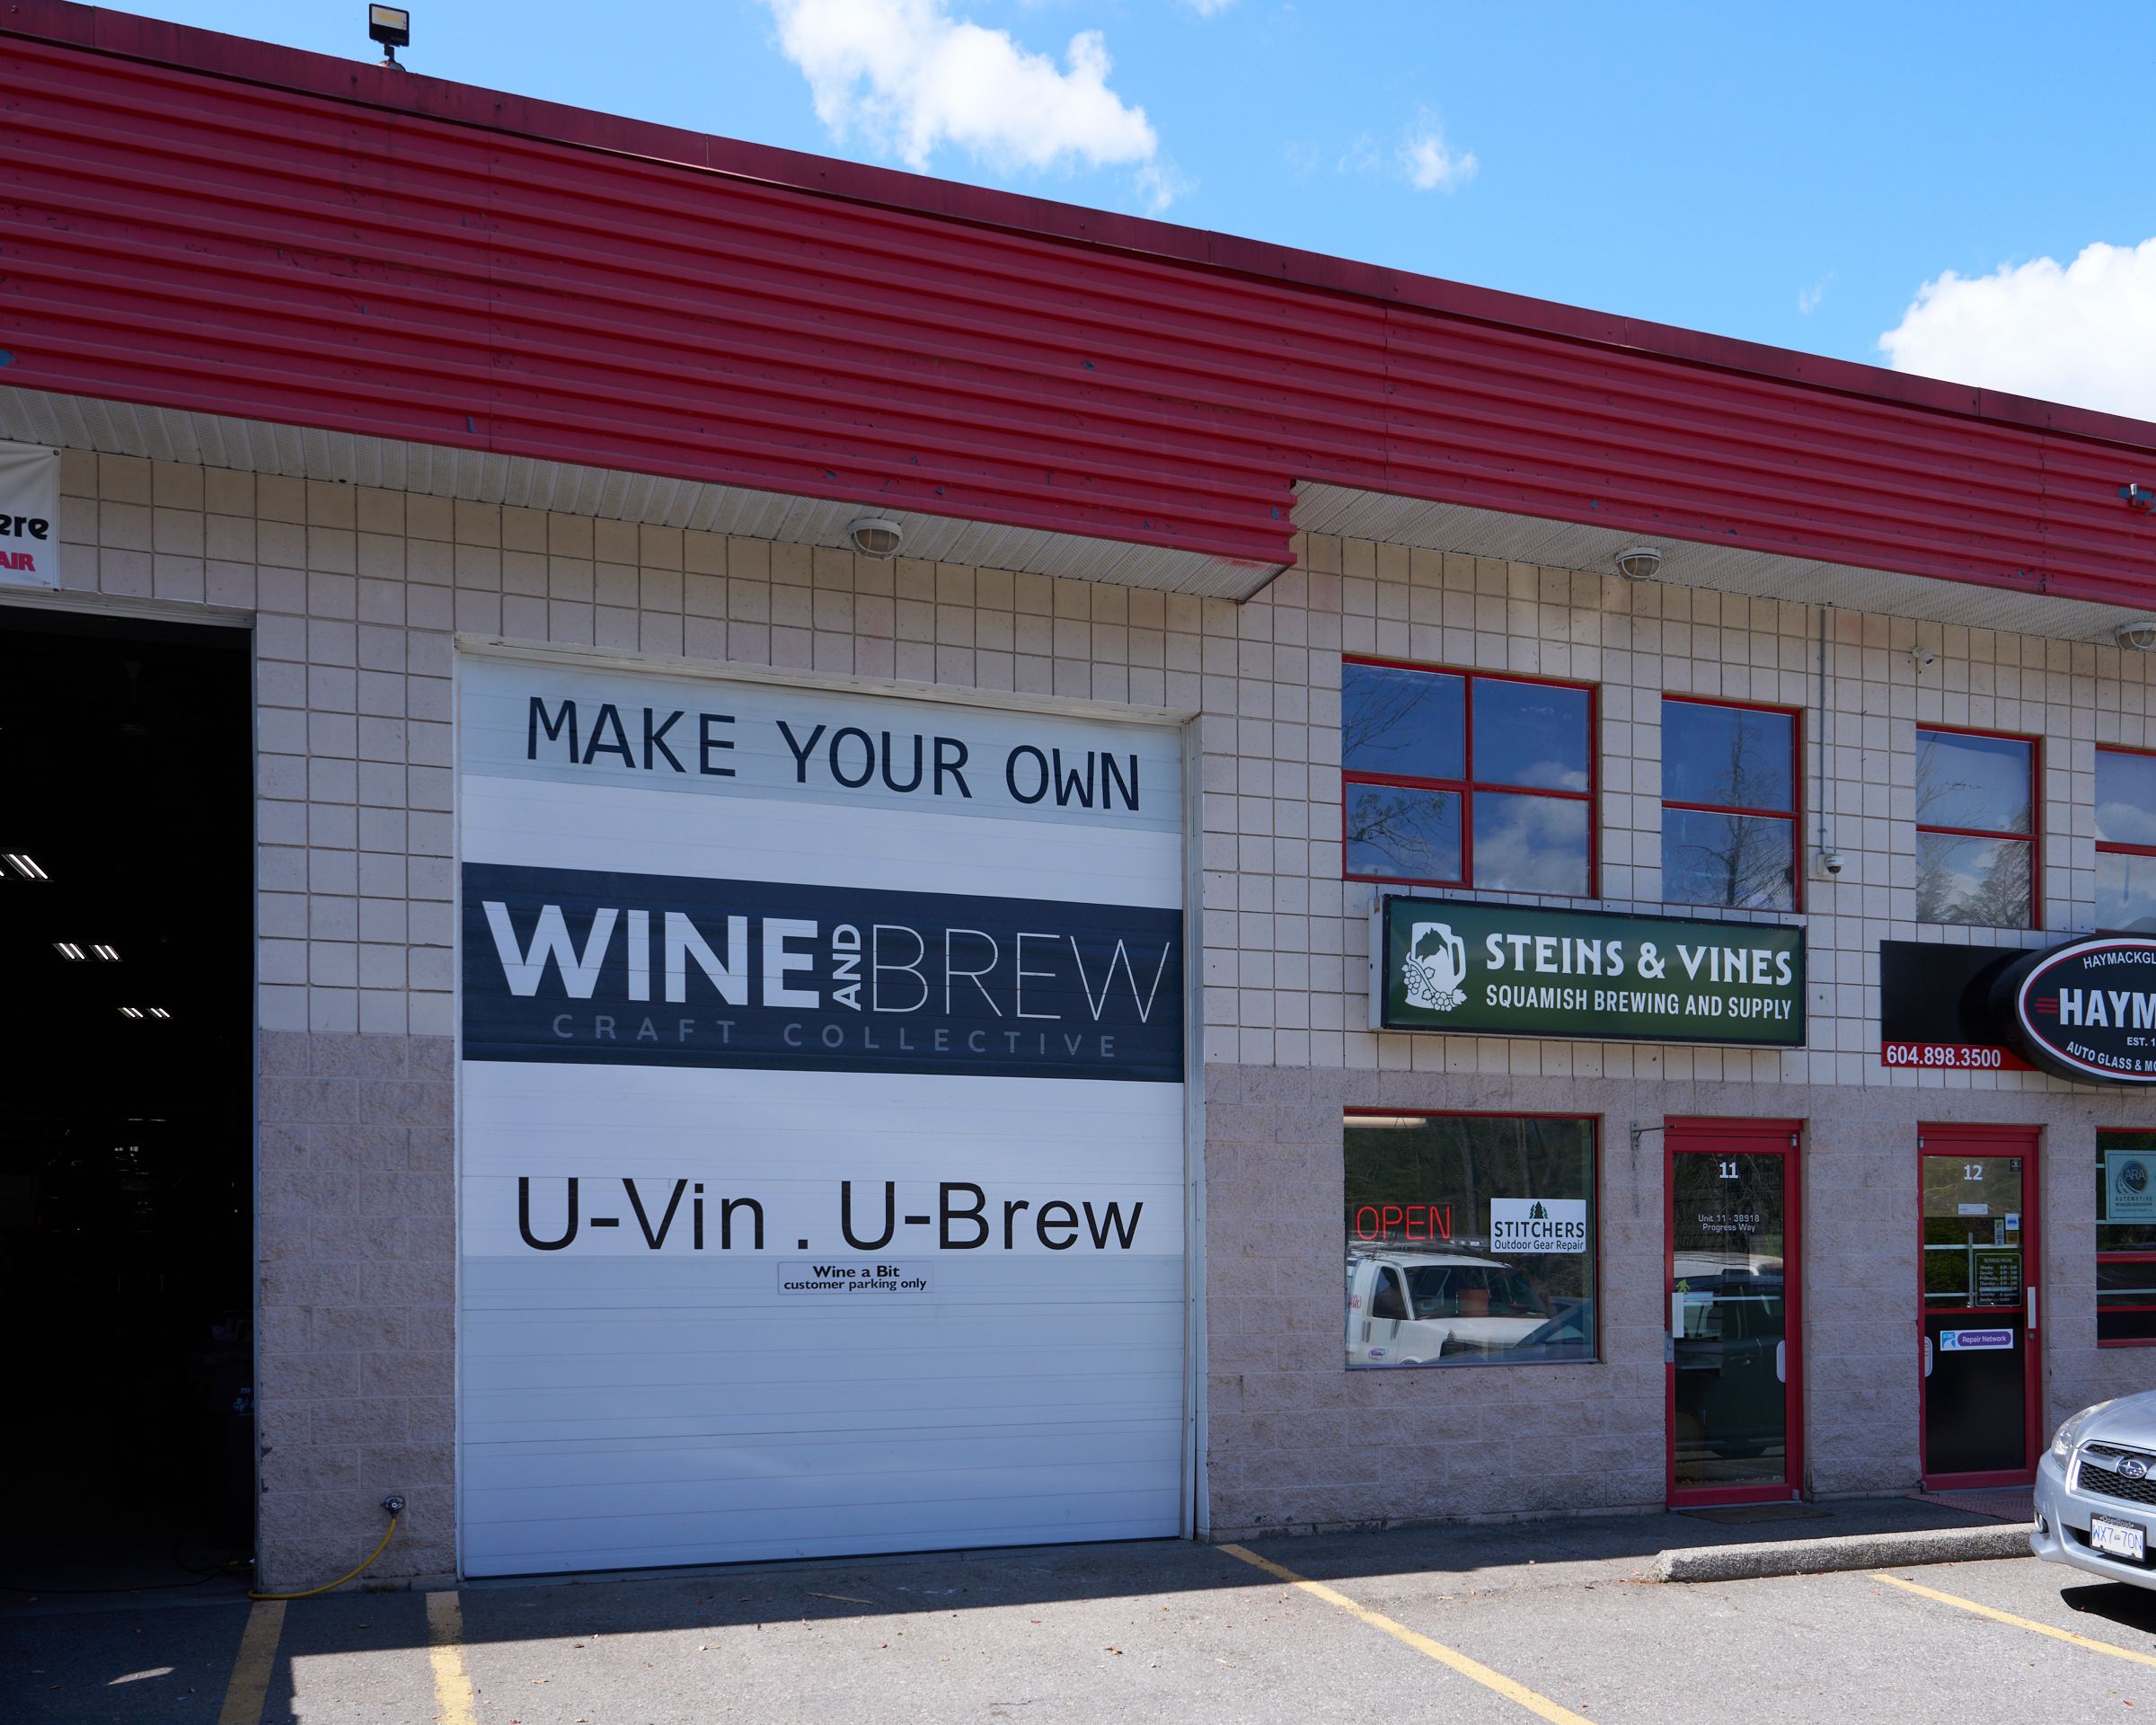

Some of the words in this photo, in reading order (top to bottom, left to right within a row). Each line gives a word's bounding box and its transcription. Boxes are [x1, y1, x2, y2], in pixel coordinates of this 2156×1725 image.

[527, 696, 736, 777] MAKE
[775, 721, 972, 799] YOUR
[1006, 745, 1139, 811] OWN
[482, 900, 819, 1009] WINE
[832, 924, 862, 1011] AND
[873, 924, 1171, 1023] BREW
[1485, 933, 1624, 977] STEINS
[1637, 941, 1666, 980] &
[1675, 943, 1793, 986] VINES
[1485, 984, 1587, 1011] SQUAMISH
[1594, 987, 1679, 1015] BREWING
[1684, 995, 1723, 1017] AND
[1727, 996, 1792, 1021] SUPPLY
[552, 1013, 735, 1044] CRAFT
[783, 1022, 1115, 1057] COLLECTIVE
[2126, 1037, 2148, 1047] EST.
[1886, 1045, 2001, 1067] 604.898.3500
[2066, 1040, 2096, 1061] AUTO
[2098, 1052, 2132, 1070] GLASS
[2134, 1059, 2142, 1071] &
[1719, 1162, 1739, 1179] 11
[1964, 1164, 1983, 1181] 12
[2125, 1169, 2146, 1181] ARA
[518, 1176, 764, 1251] U-Vin
[841, 1181, 1144, 1251] U-Brew
[1356, 1206, 1450, 1240] OPEN
[1494, 1221, 1585, 1238] STITCHERS
[1702, 1223, 1736, 1233] Progress
[1738, 1223, 1755, 1233] Way
[1494, 1240, 1532, 1250] Outdoor
[1533, 1241, 1554, 1250] Gear
[1556, 1241, 1584, 1252] Repair
[812, 1265, 856, 1278] Wine
[861, 1269, 870, 1278] a
[877, 1265, 900, 1278] Bit
[784, 1280, 844, 1290] customer
[849, 1278, 897, 1291] parking
[901, 1278, 927, 1291] only
[1962, 1336, 1981, 1344] Repair
[2102, 1515, 2132, 1528] OpenRoad
